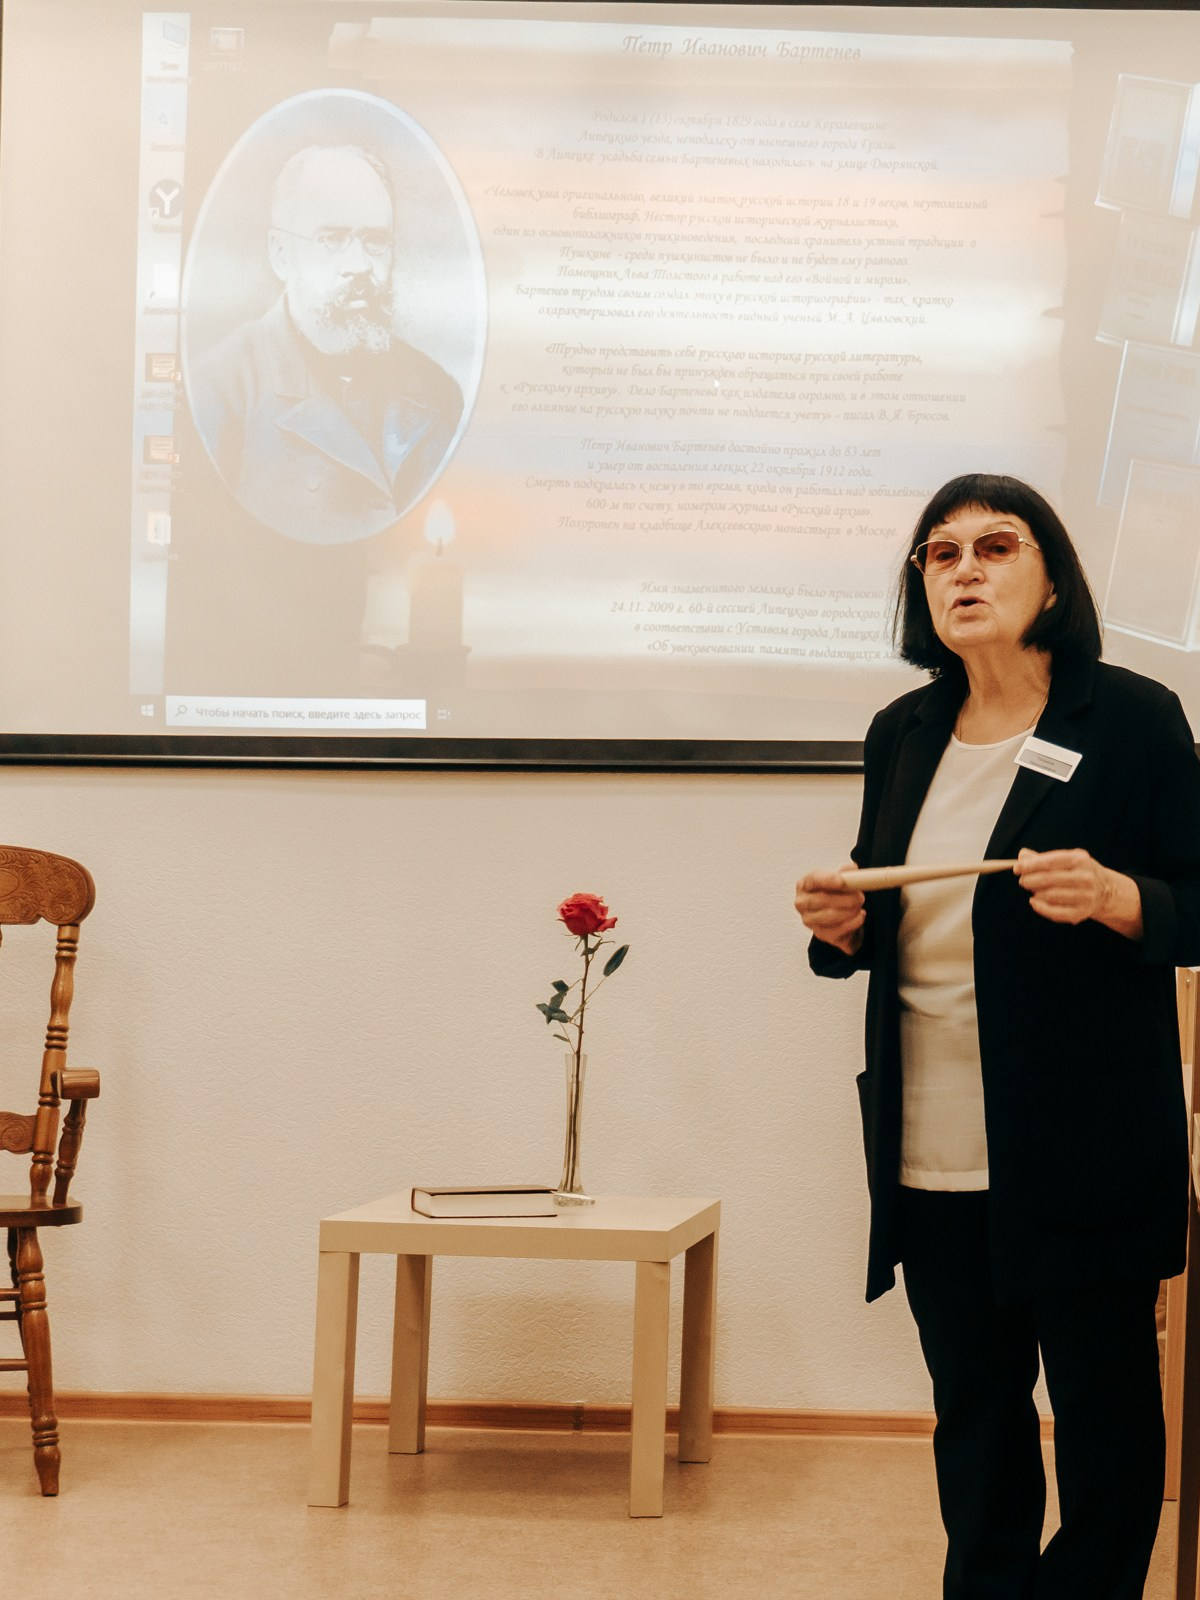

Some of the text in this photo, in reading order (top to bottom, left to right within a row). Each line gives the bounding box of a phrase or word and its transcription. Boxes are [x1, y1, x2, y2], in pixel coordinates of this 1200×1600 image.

[622, 35, 862, 63] Петр Иванович Бартенев
[543, 148, 596, 163] Липецке
[600, 150, 643, 166] усадьба
[646, 155, 679, 163] семьи
[680, 153, 751, 168] Бартеневых
[752, 157, 815, 168] находилась
[820, 160, 833, 168] на
[836, 161, 869, 172] улице
[536, 190, 560, 202] ума
[649, 193, 695, 205] великий
[697, 196, 742, 208] знаток
[739, 195, 783, 208] русской
[786, 199, 834, 210] истории
[837, 197, 850, 207] 18
[863, 197, 876, 208] 19
[913, 200, 989, 212] неутомимый
[643, 211, 687, 225] Нестор
[688, 214, 732, 226] русской
[734, 216, 811, 228] исторической
[493, 224, 521, 236] один
[539, 229, 642, 243] основоположников
[744, 233, 801, 245] последний
[803, 237, 864, 249] хранитель
[864, 236, 905, 250] устной
[908, 235, 965, 250] традиции
[560, 246, 863, 269] Пушкине среди пушкинистов было будет ему
[556, 266, 625, 281] Помощник
[621, 268, 650, 281] Льва
[651, 269, 711, 280] Толстого
[721, 270, 761, 285] работе
[763, 272, 784, 283] над
[514, 284, 570, 299] Бартенев
[571, 287, 616, 300] трудом
[618, 290, 651, 298] своим
[734, 293, 778, 305] русской
[912, 297, 955, 308] кратко
[538, 307, 823, 326] охарактеризовал его деятельность видный ученый
[545, 342, 597, 358] «Трудно
[599, 344, 673, 359] представить
[675, 345, 697, 357] себе
[698, 350, 746, 361] русского
[748, 352, 802, 364] историка
[804, 351, 847, 365] русской
[562, 364, 904, 385] который был принужден обращаться при своей работе
[627, 384, 657, 396] Дело
[658, 385, 718, 400] Бартенева
[720, 389, 744, 400] как
[744, 388, 796, 400] издателя
[869, 392, 900, 400] этом
[902, 394, 967, 402] отношении
[512, 404, 529, 412] его
[531, 404, 577, 413] влияние
[596, 406, 642, 419] русскую
[644, 408, 677, 419] науку
[733, 406, 791, 419] поддается
[843, 412, 876, 420] писал
[580, 438, 882, 459] Петр Иванович Бартенев достойно прожил лет
[596, 462, 626, 474] умер
[646, 463, 709, 471] воспаления
[711, 464, 751, 475] легких
[767, 463, 816, 479] октября
[819, 466, 846, 476] 1912
[525, 476, 571, 491] Смерть
[573, 477, 637, 493] подкралась
[648, 483, 678, 495] нему
[746, 482, 777, 495] когда
[795, 483, 844, 498] работал
[846, 485, 866, 496] над
[677, 503, 727, 514] номером
[729, 503, 778, 515] журнала
[781, 503, 831, 518] «Русский
[559, 516, 841, 539] Похоронен кладбище Алексеевского монастыря
[640, 581, 669, 593] Имя
[671, 585, 745, 594] знаменитого
[748, 585, 796, 598] земляка
[798, 584, 827, 597] было
[648, 602, 674, 613] 2009
[689, 603, 714, 613] 60-й
[716, 603, 756, 613] сессией
[756, 603, 819, 619] Липецкого
[643, 624, 725, 633] соответствии
[735, 622, 789, 635] Уставом
[792, 626, 829, 640] города
[830, 627, 881, 642] Липецка
[760, 646, 807, 656] памяти
[196, 707, 421, 722] Чтобы начать поиск, введите здесь запрос
